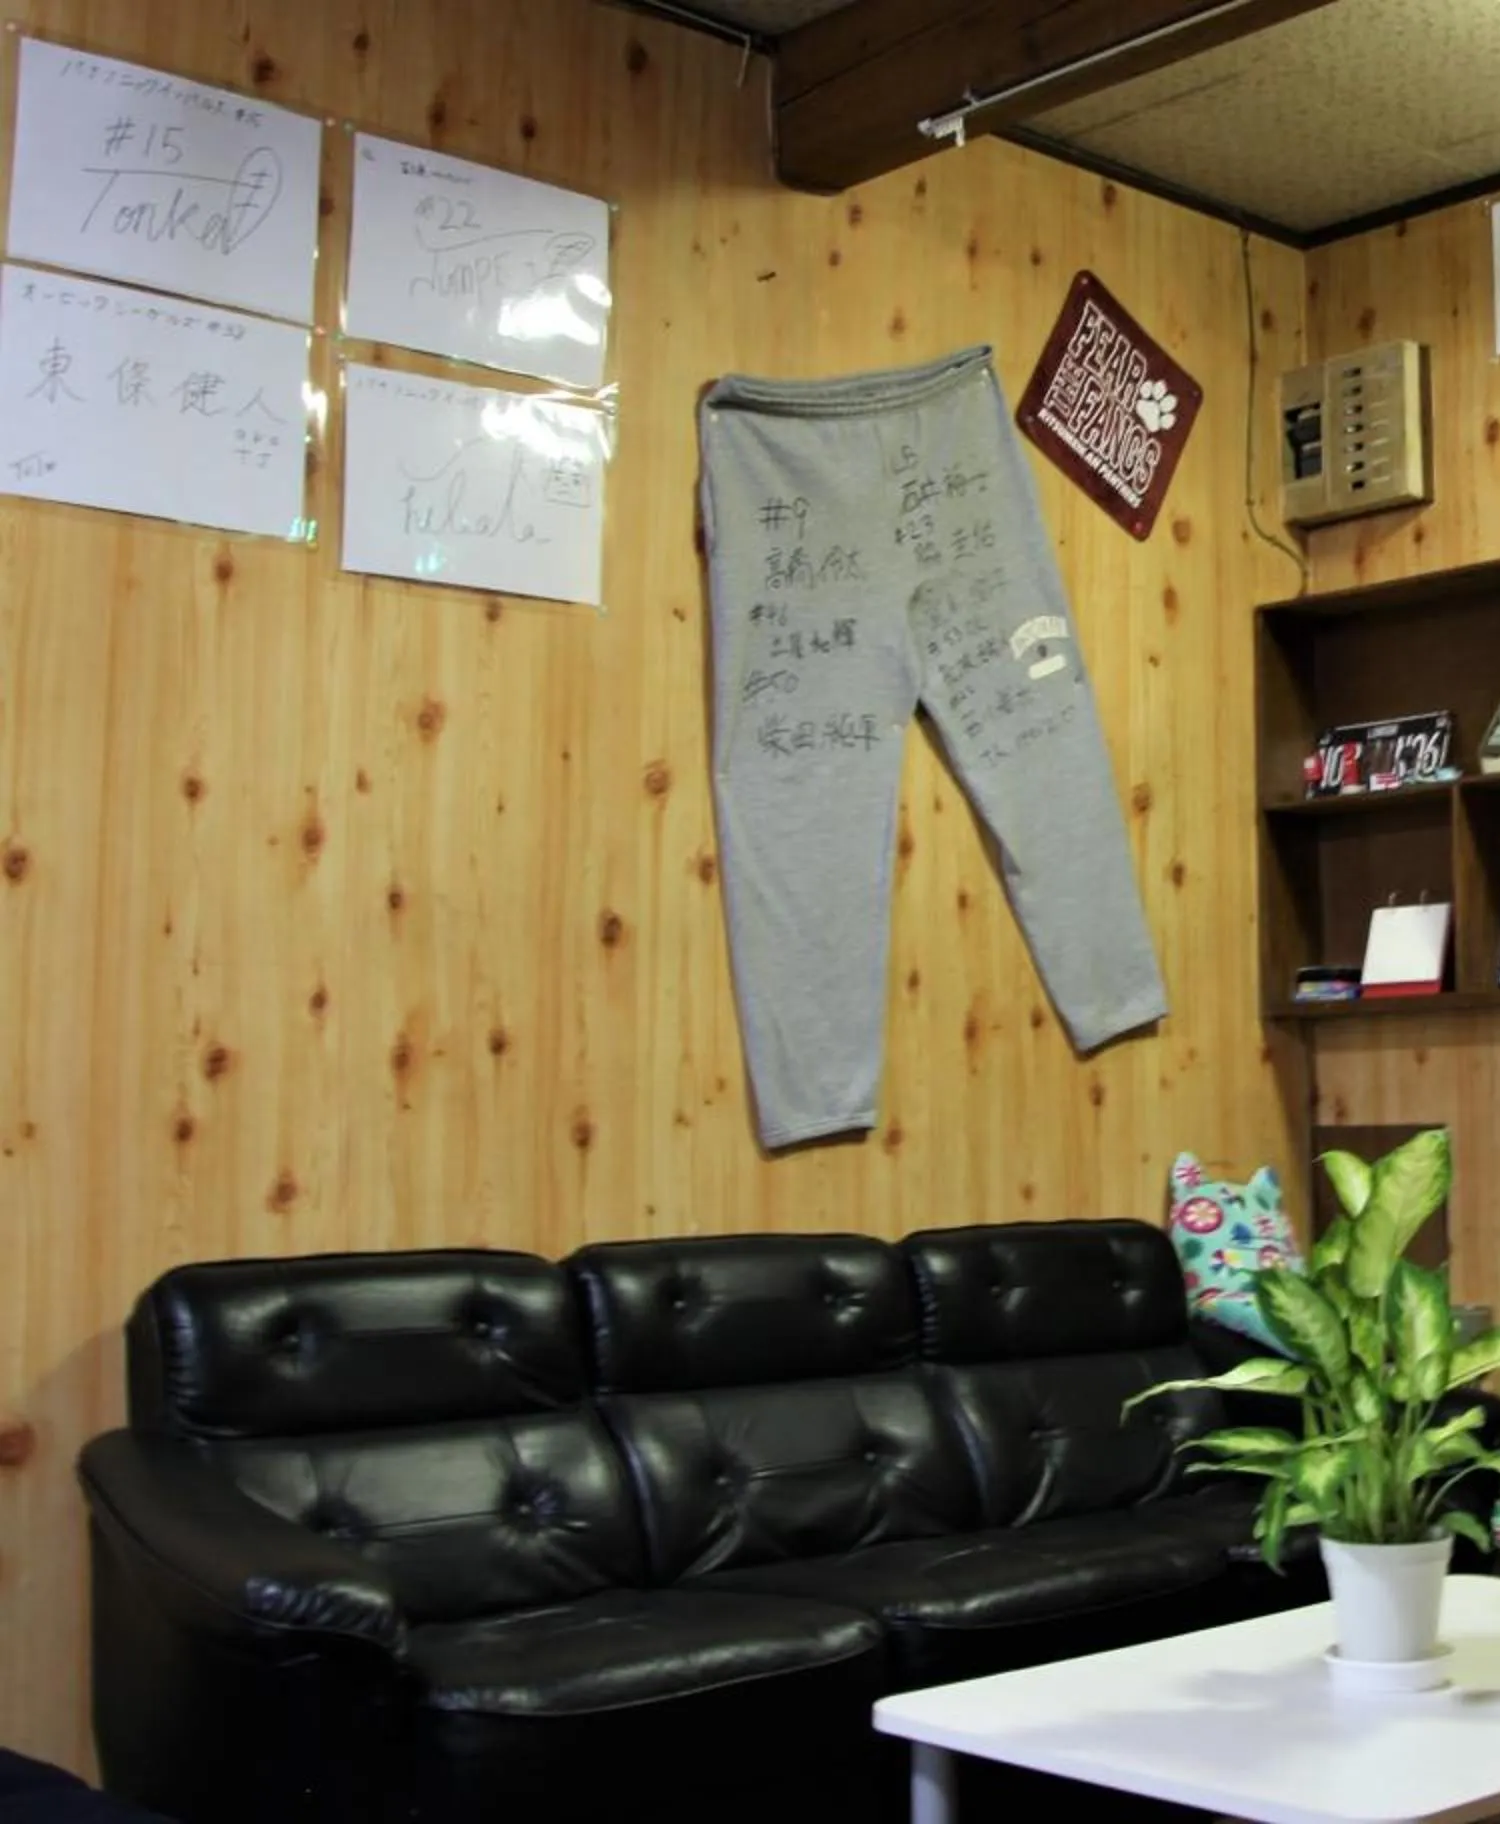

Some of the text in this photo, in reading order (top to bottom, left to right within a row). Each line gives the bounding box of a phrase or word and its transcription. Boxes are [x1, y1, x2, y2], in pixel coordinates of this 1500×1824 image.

[104, 115, 185, 164] #15
[1043, 352, 1088, 417] THE
[1067, 299, 1148, 413] FEAR
[1067, 375, 1162, 495] FANGS
[757, 495, 812, 541] #9
